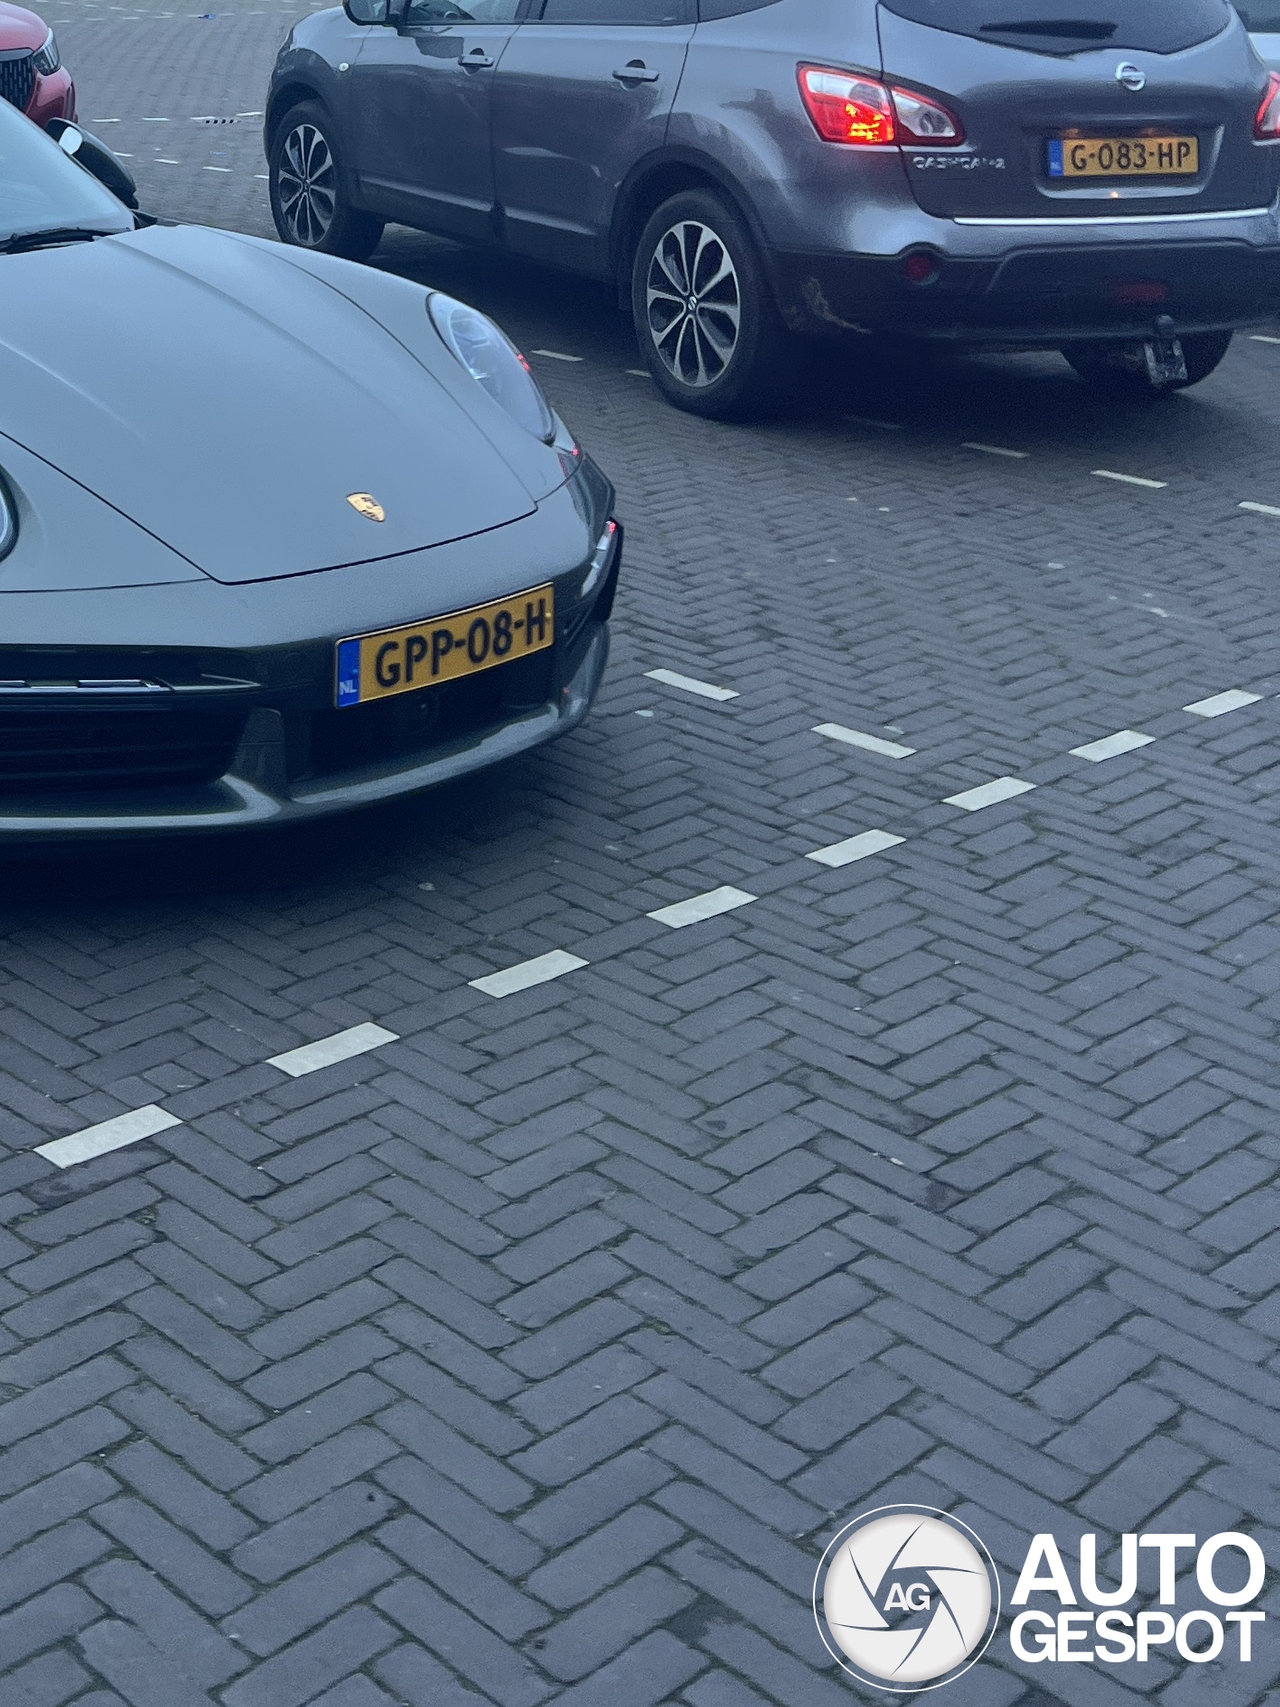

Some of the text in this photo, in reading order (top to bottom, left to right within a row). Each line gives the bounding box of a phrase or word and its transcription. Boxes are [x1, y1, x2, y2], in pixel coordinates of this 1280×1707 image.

[1071, 141, 1192, 171] G-083-HP
[375, 598, 546, 688] GPP-08-H
[338, 678, 358, 695] NL
